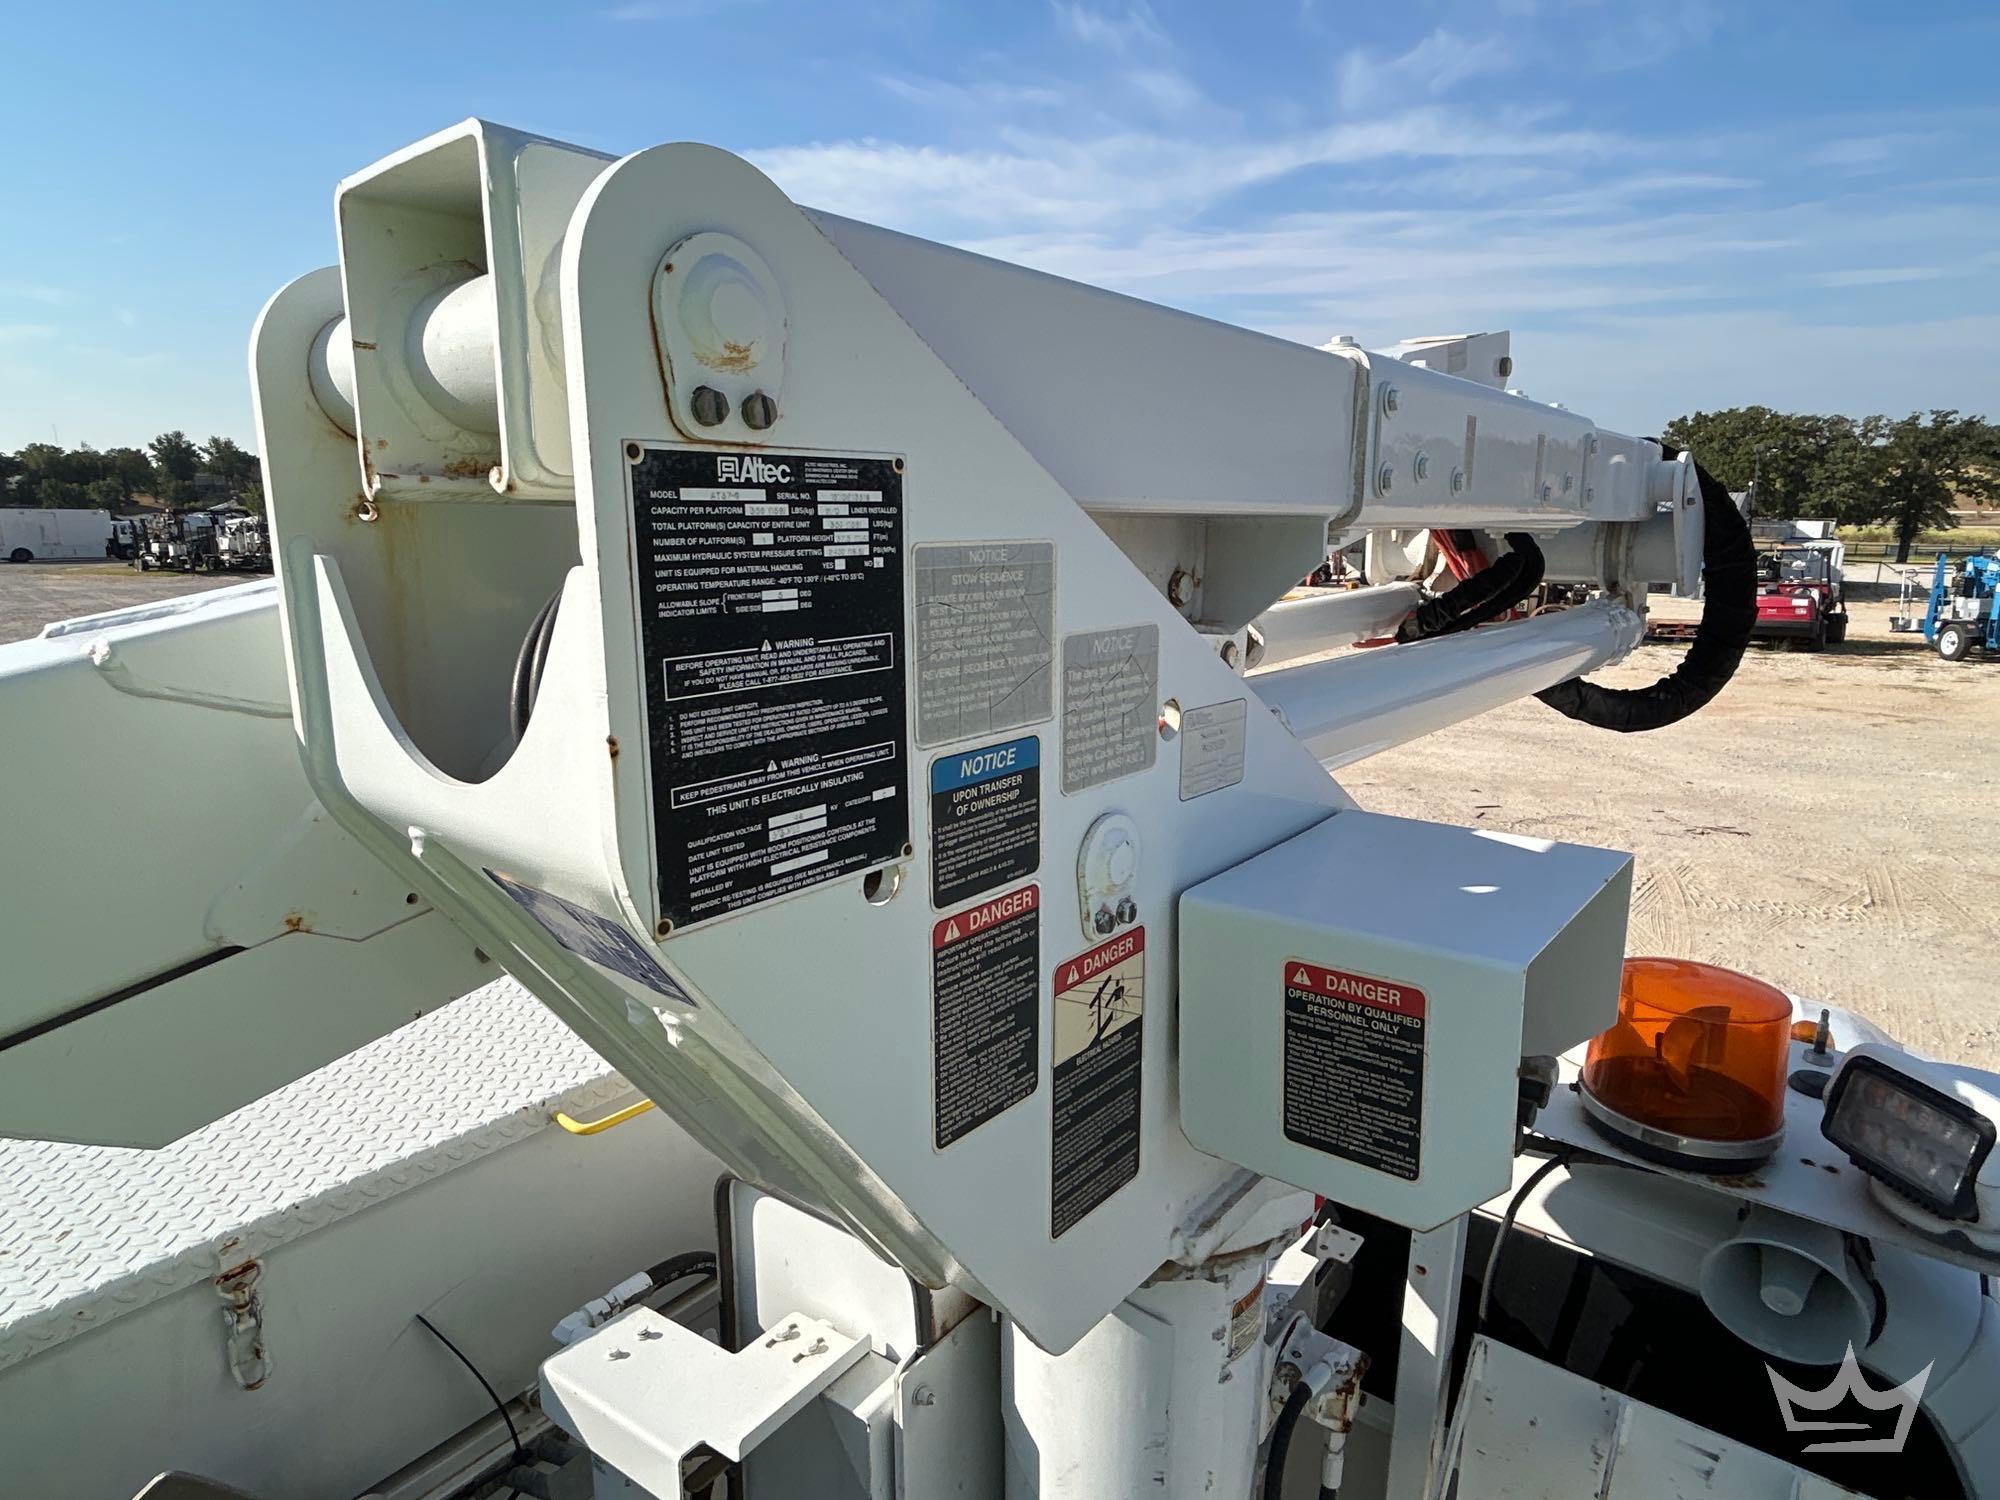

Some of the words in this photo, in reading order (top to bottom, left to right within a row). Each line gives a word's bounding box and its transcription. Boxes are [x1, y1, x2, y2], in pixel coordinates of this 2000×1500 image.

[740, 457, 790, 483] Altec
[970, 549, 1007, 563] NOTICE
[684, 568, 719, 576] EQUIPPED
[952, 574, 977, 585] STOW
[980, 570, 1024, 583] SEQUENCE
[656, 583, 698, 592] OPERATING
[700, 579, 750, 589] TEMPERATURE
[659, 600, 698, 609] ALLOWABLE
[659, 609, 694, 618] INDICATOR
[775, 638, 814, 649] WARNING
[1094, 634, 1134, 653] NOTICE
[676, 663, 703, 671] BEFORE
[705, 657, 742, 668] OPERATING
[793, 646, 831, 656] UNDERSTAND
[843, 641, 873, 650] OPERATING
[700, 668, 724, 676] SAFETY
[726, 662, 769, 672] INFORMATION
[746, 671, 768, 679] MANUAL
[923, 666, 960, 679] REVERSE
[962, 659, 1005, 673] SEQUENCE
[781, 754, 819, 768] WARNING
[961, 748, 1016, 778] NOTICE
[680, 791, 699, 800] KEEP
[700, 780, 746, 797] PEDESTRIANS
[748, 776, 766, 786] AWAY
[767, 771, 786, 780] FROM
[802, 762, 826, 773] VEHICLE
[845, 752, 875, 763] OPERATING
[706, 804, 727, 816] THIS
[729, 799, 749, 810] UNIT
[752, 796, 760, 805] IS
[762, 782, 818, 803] ELECTRICALLY
[821, 772, 864, 788] INSULATING
[953, 787, 977, 802] UPON
[979, 774, 1022, 794] TRANSFER
[957, 804, 968, 816] OF
[971, 789, 1019, 812] OWNERSHIP
[688, 831, 735, 848] QUALIFICATION
[736, 824, 762, 836] VOLTAGE
[688, 853, 704, 862] DATE
[706, 849, 720, 857] UNIT
[722, 842, 745, 853] TESTED
[689, 866, 706, 875] UNIT
[715, 854, 748, 868] EQUIPPED
[750, 849, 766, 858] WITH
[767, 843, 786, 853] BOOM
[788, 832, 825, 848] POSITIONING
[827, 823, 857, 836] CONTROLS
[690, 868, 726, 884] PLATFORM
[728, 863, 744, 873] WITH
[746, 858, 762, 868] HIGH
[763, 847, 800, 863] ELECTRICAL
[801, 837, 836, 851] RESISTANCE
[690, 884, 724, 898] INSTALLED
[691, 898, 720, 912] PERIODIC
[722, 887, 757, 902] RE-TESTING
[765, 876, 793, 889] REQUIRED
[808, 860, 844, 875] MAINTENANCE
[728, 900, 741, 908] THIS
[742, 895, 756, 904] UNIT
[970, 891, 1032, 930] DANGER
[937, 956, 958, 968] Failure
[968, 945, 982, 956] obey
[1084, 937, 1133, 975] DANGER
[1326, 975, 1400, 1006] DANGER
[1288, 988, 1345, 1010] OPERATION
[1348, 1003, 1362, 1013] BY
[1364, 1007, 1421, 1028] QUALIFIED
[1308, 1004, 1368, 1027] PERSONNEL
[1371, 1020, 1399, 1035] ONLY
